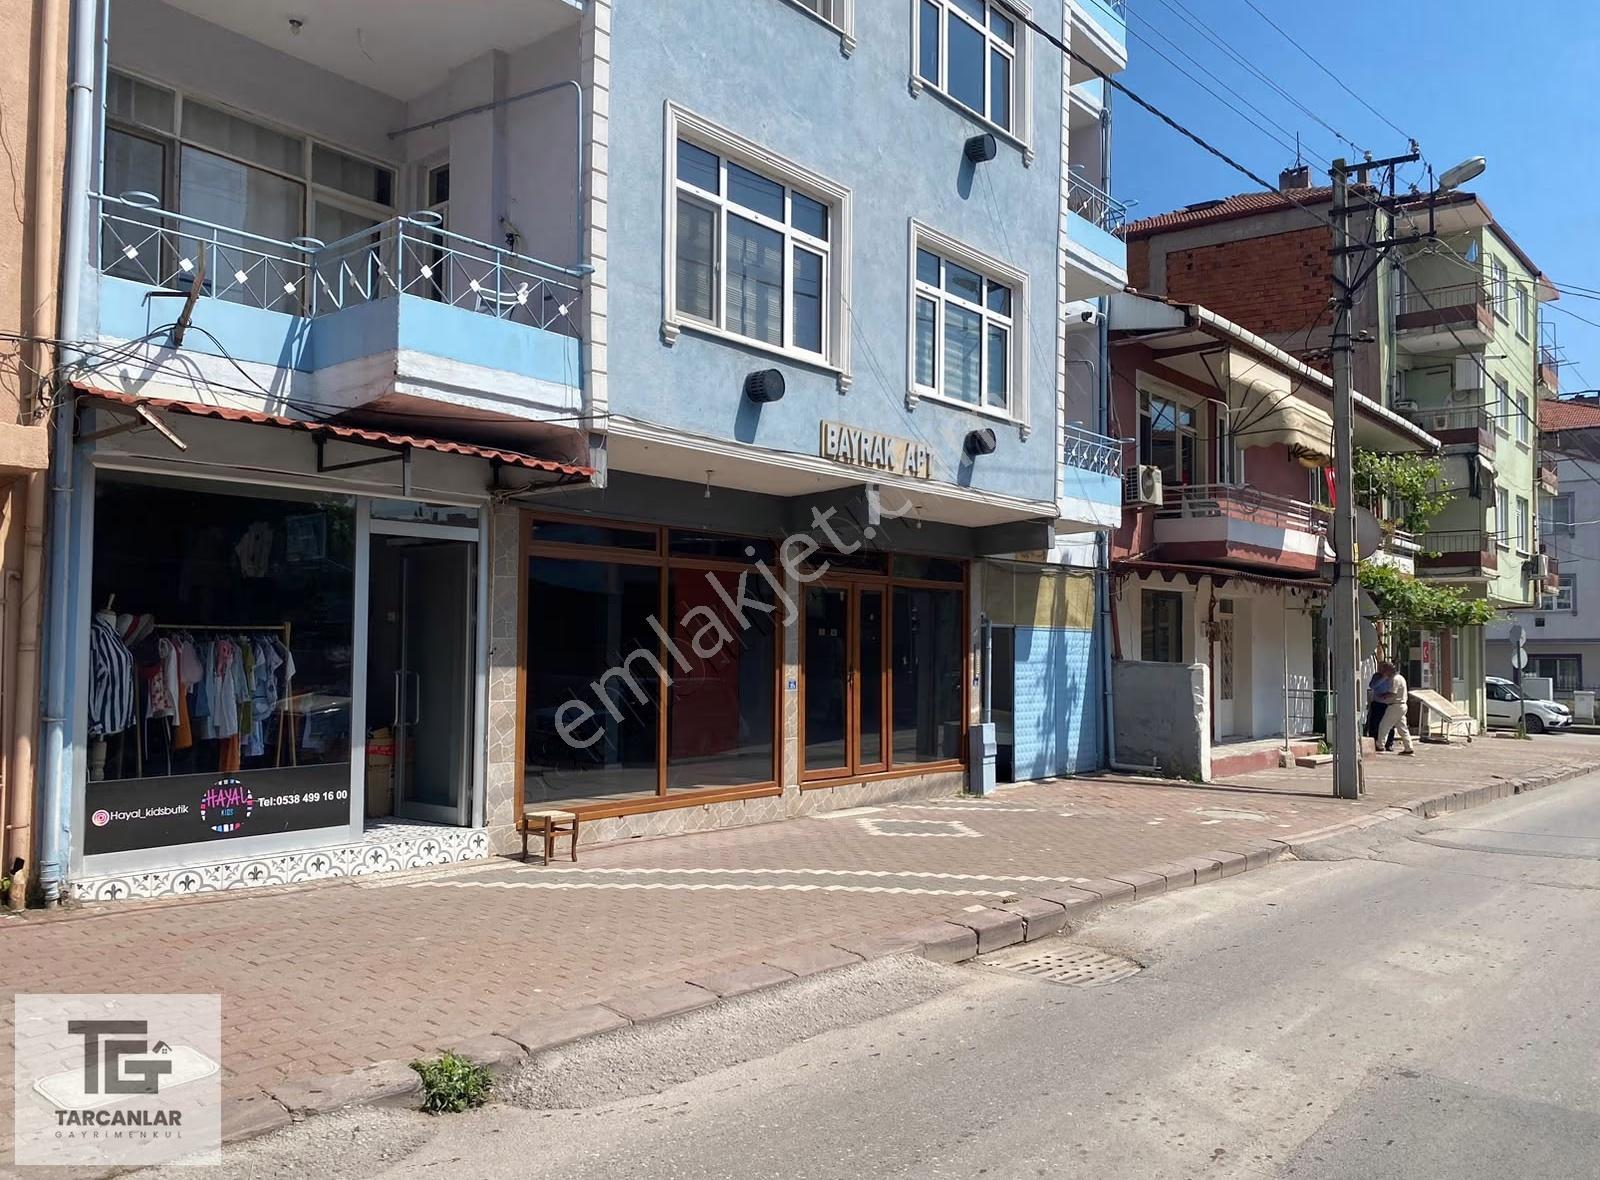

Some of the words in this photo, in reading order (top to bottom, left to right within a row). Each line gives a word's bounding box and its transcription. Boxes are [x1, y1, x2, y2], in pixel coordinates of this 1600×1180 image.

[824, 423, 894, 471] BAYRAK
[904, 442, 934, 479] APT
[206, 786, 248, 808] HAYAL
[258, 794, 300, 807] Tel:0538
[302, 792, 320, 803] 499
[322, 790, 334, 801] 16
[336, 789, 348, 800] 00
[110, 804, 189, 821] Hayal_kidsbutik
[221, 808, 234, 816] KIDS
